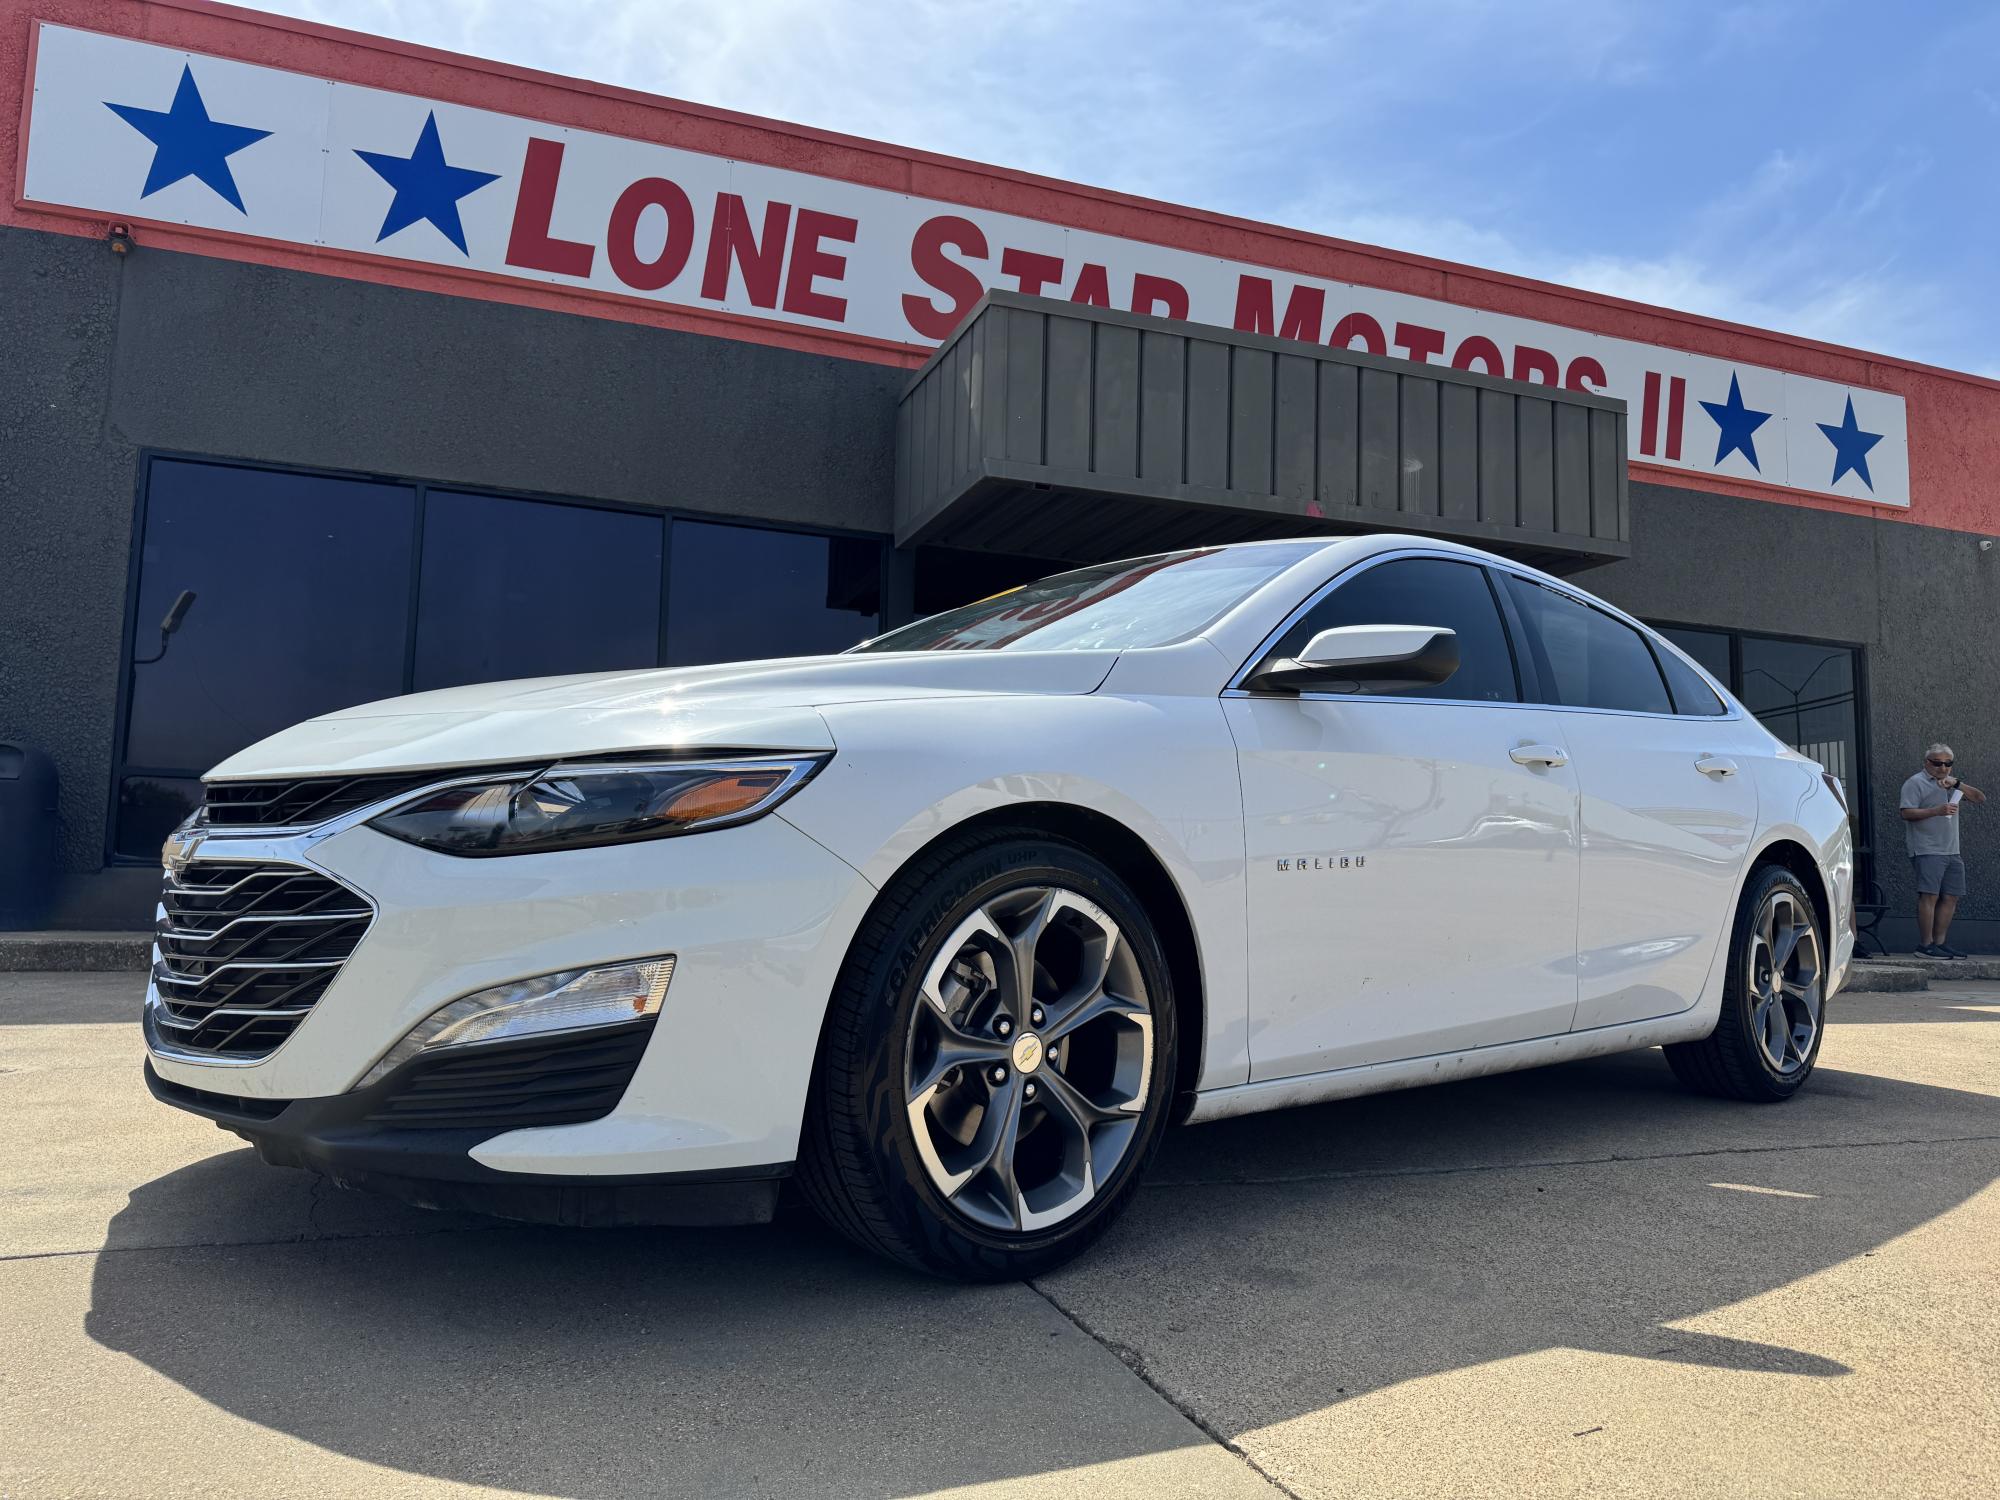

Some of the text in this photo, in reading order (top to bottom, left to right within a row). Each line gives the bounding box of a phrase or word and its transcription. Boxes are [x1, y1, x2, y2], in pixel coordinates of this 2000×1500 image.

[505, 138, 857, 322] LONE
[1640, 371, 1686, 461] II
[1006, 849, 1039, 865] UHP
[1276, 855, 1367, 872] MALIBU
